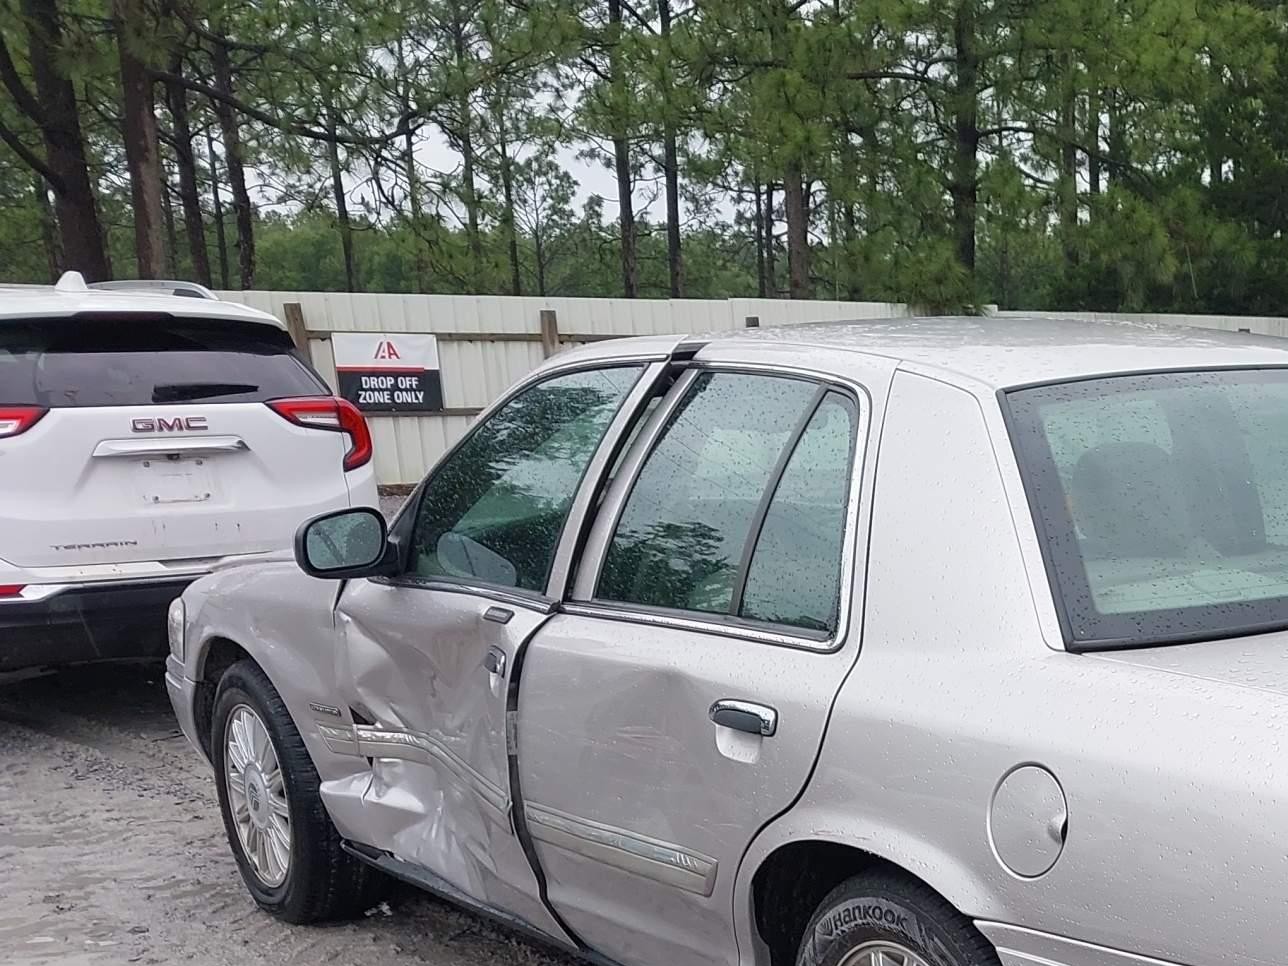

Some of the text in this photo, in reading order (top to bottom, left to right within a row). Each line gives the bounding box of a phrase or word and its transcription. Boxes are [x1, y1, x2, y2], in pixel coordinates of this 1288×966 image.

[361, 376, 420, 389] DROP OFF
[358, 391, 424, 404] ZONE ONLY
[130, 416, 209, 433] GMC
[50, 540, 138, 551] TERRAIN
